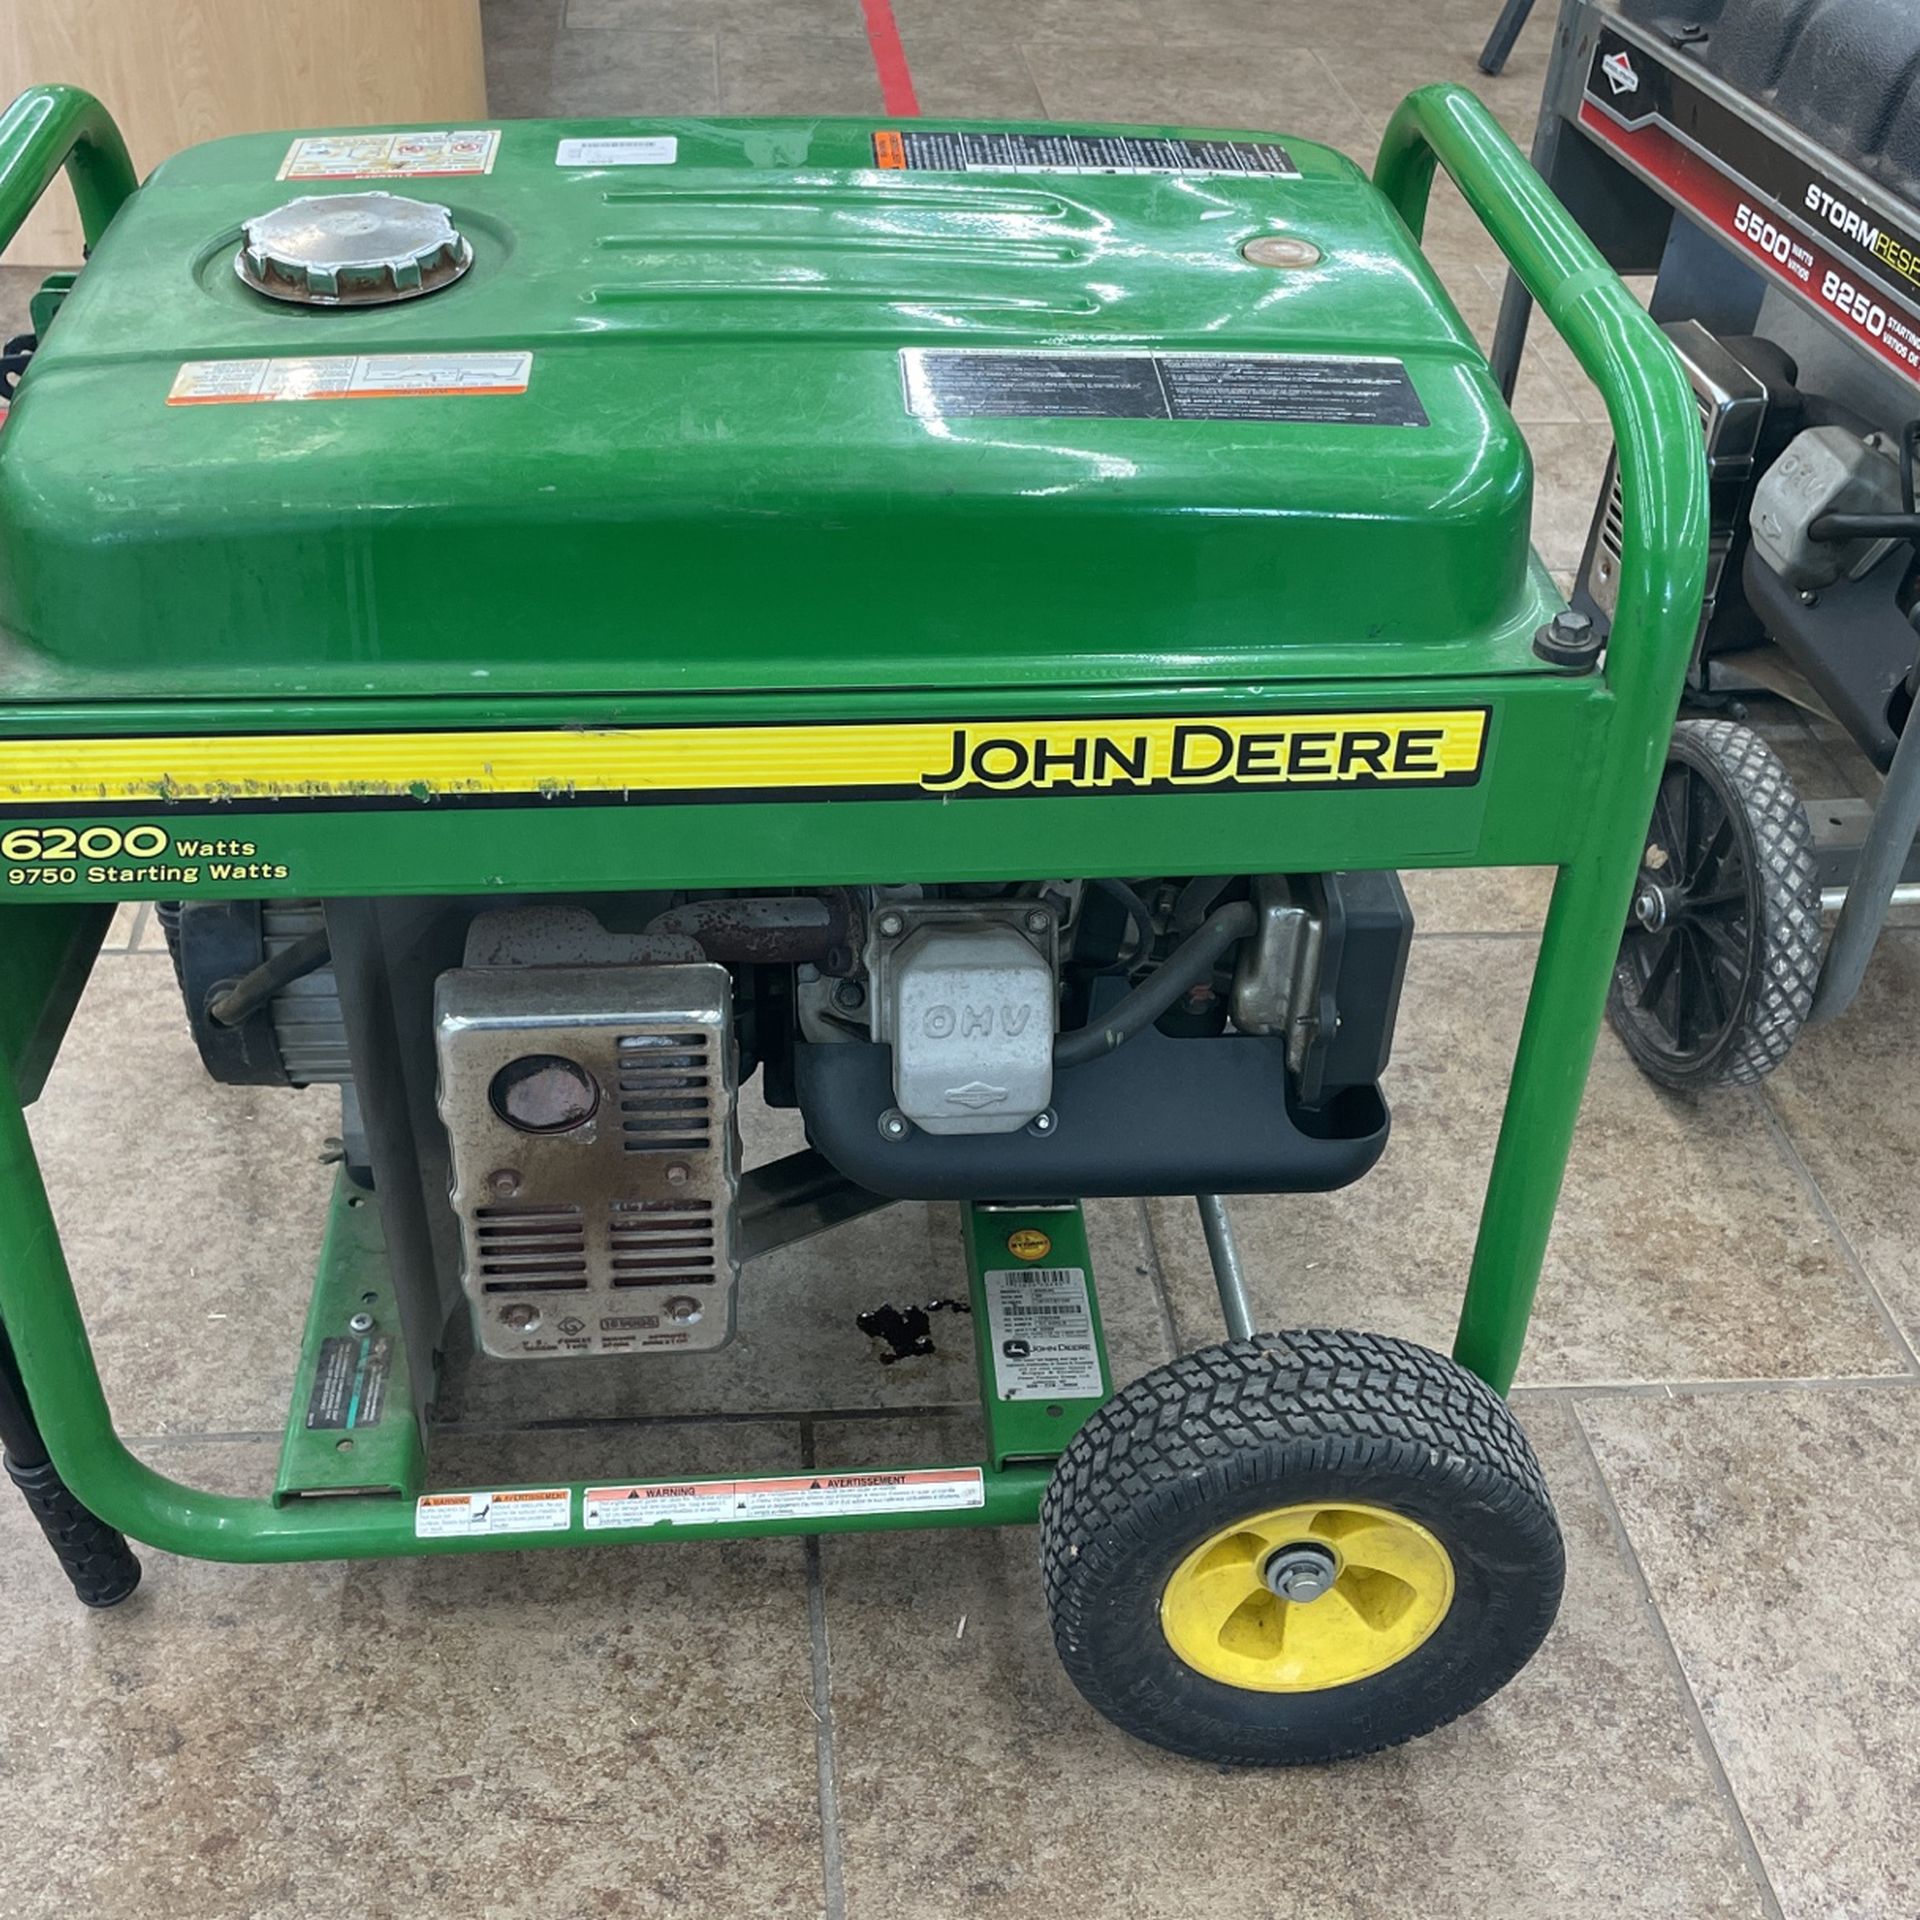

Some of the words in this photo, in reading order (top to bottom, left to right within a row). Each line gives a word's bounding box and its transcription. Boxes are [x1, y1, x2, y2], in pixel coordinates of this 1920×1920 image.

[1734, 203, 1791, 264] 5500
[1792, 243, 1814, 267] WATTS
[1821, 270, 1886, 336] 8250
[920, 730, 1148, 784] JOHN
[1171, 725, 1444, 778] DEERE
[1, 826, 168, 861] 6200
[176, 841, 256, 857] Watts
[9, 868, 76, 884] 9750
[88, 865, 199, 883] Starting
[209, 863, 288, 880] Watts
[923, 1004, 1031, 1039] OHV
[645, 1487, 696, 1498] WARNING
[827, 1476, 906, 1489] AVERTISSEMENT
